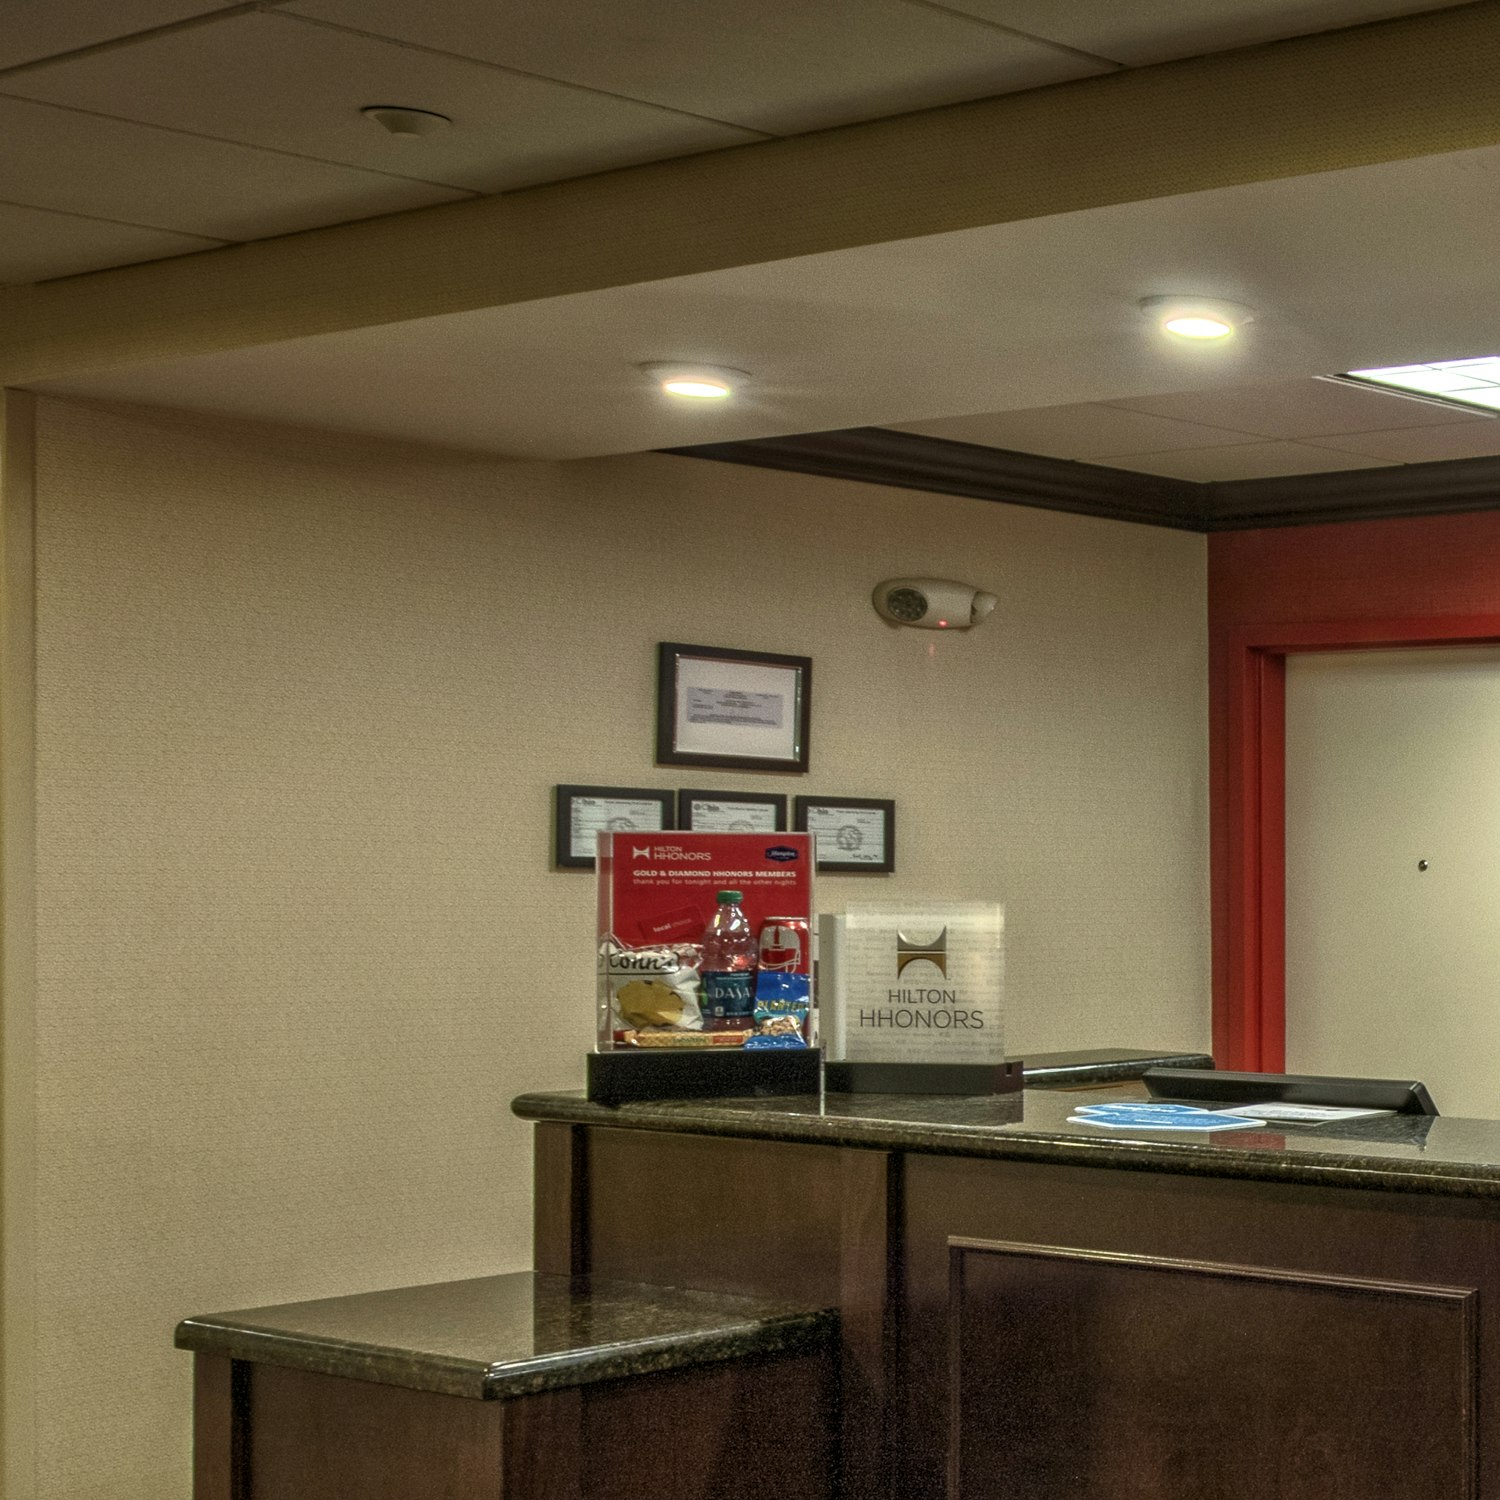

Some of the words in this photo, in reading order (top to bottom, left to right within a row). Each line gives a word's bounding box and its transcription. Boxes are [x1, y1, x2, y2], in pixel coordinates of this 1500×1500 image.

[654, 852, 711, 861] HHONORS
[684, 878, 711, 887] tonight
[715, 987, 752, 999] DASA
[888, 989, 956, 1004] HILTON
[860, 1009, 984, 1029] HHONORS
